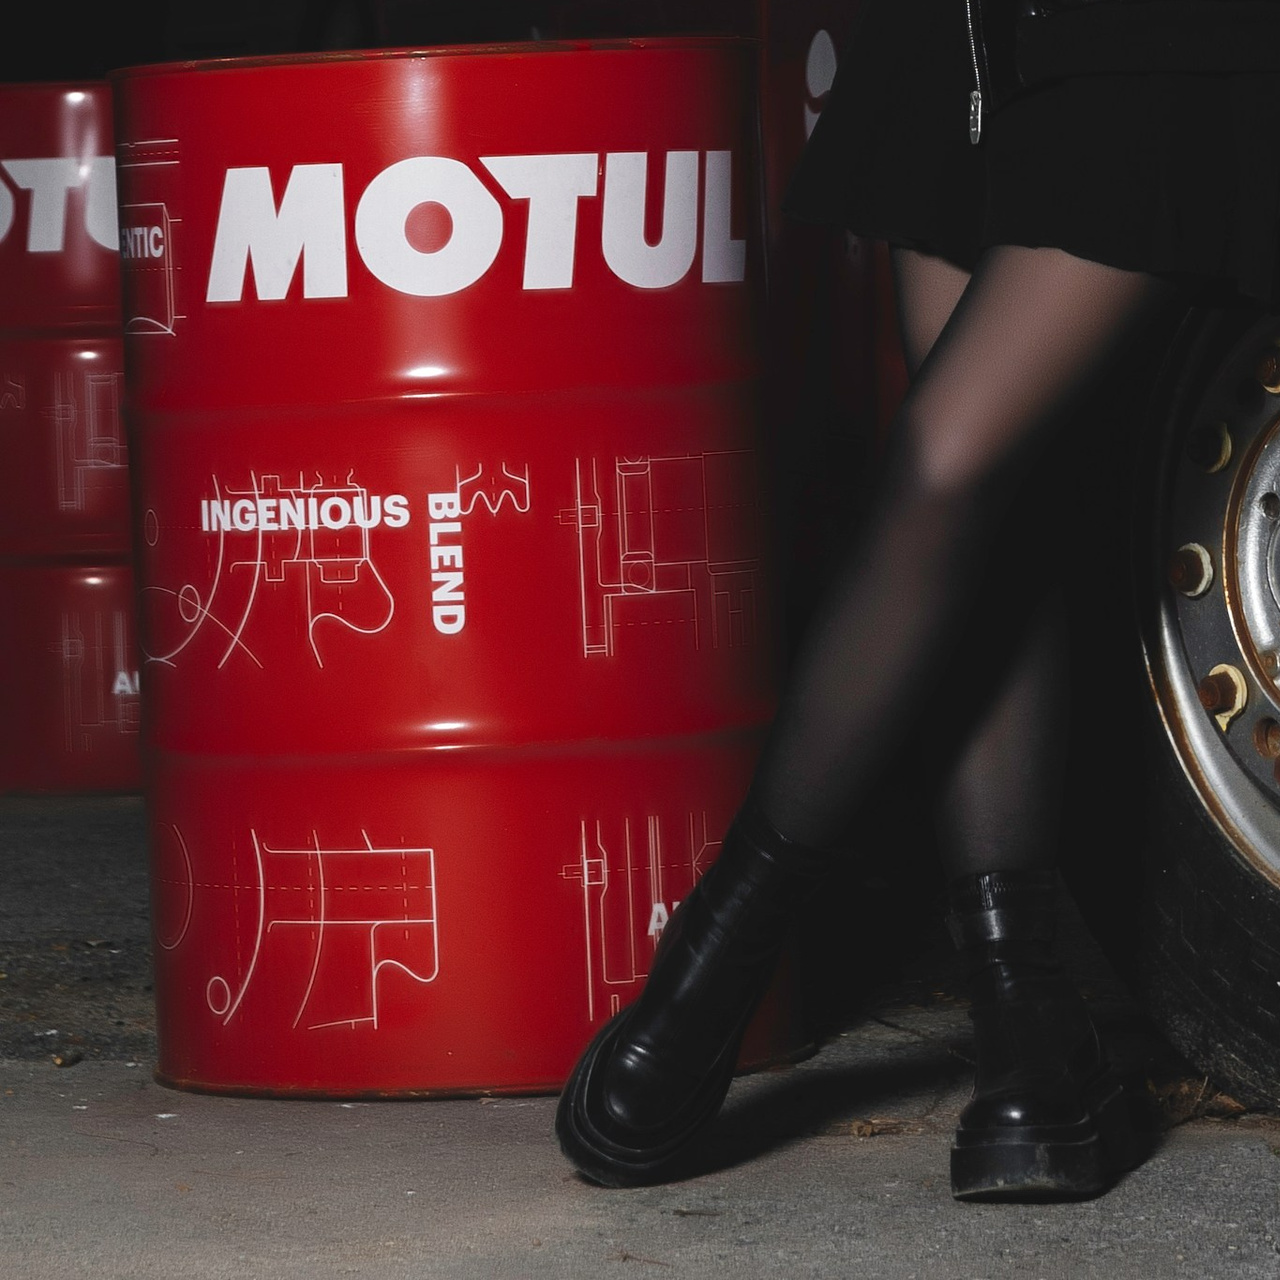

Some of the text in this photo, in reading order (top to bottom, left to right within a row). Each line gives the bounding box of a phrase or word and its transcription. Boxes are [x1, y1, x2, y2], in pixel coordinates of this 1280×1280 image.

[205, 150, 747, 303] MOTUL
[201, 495, 411, 532] INGENIOUS
[427, 492, 466, 635] BLEND
